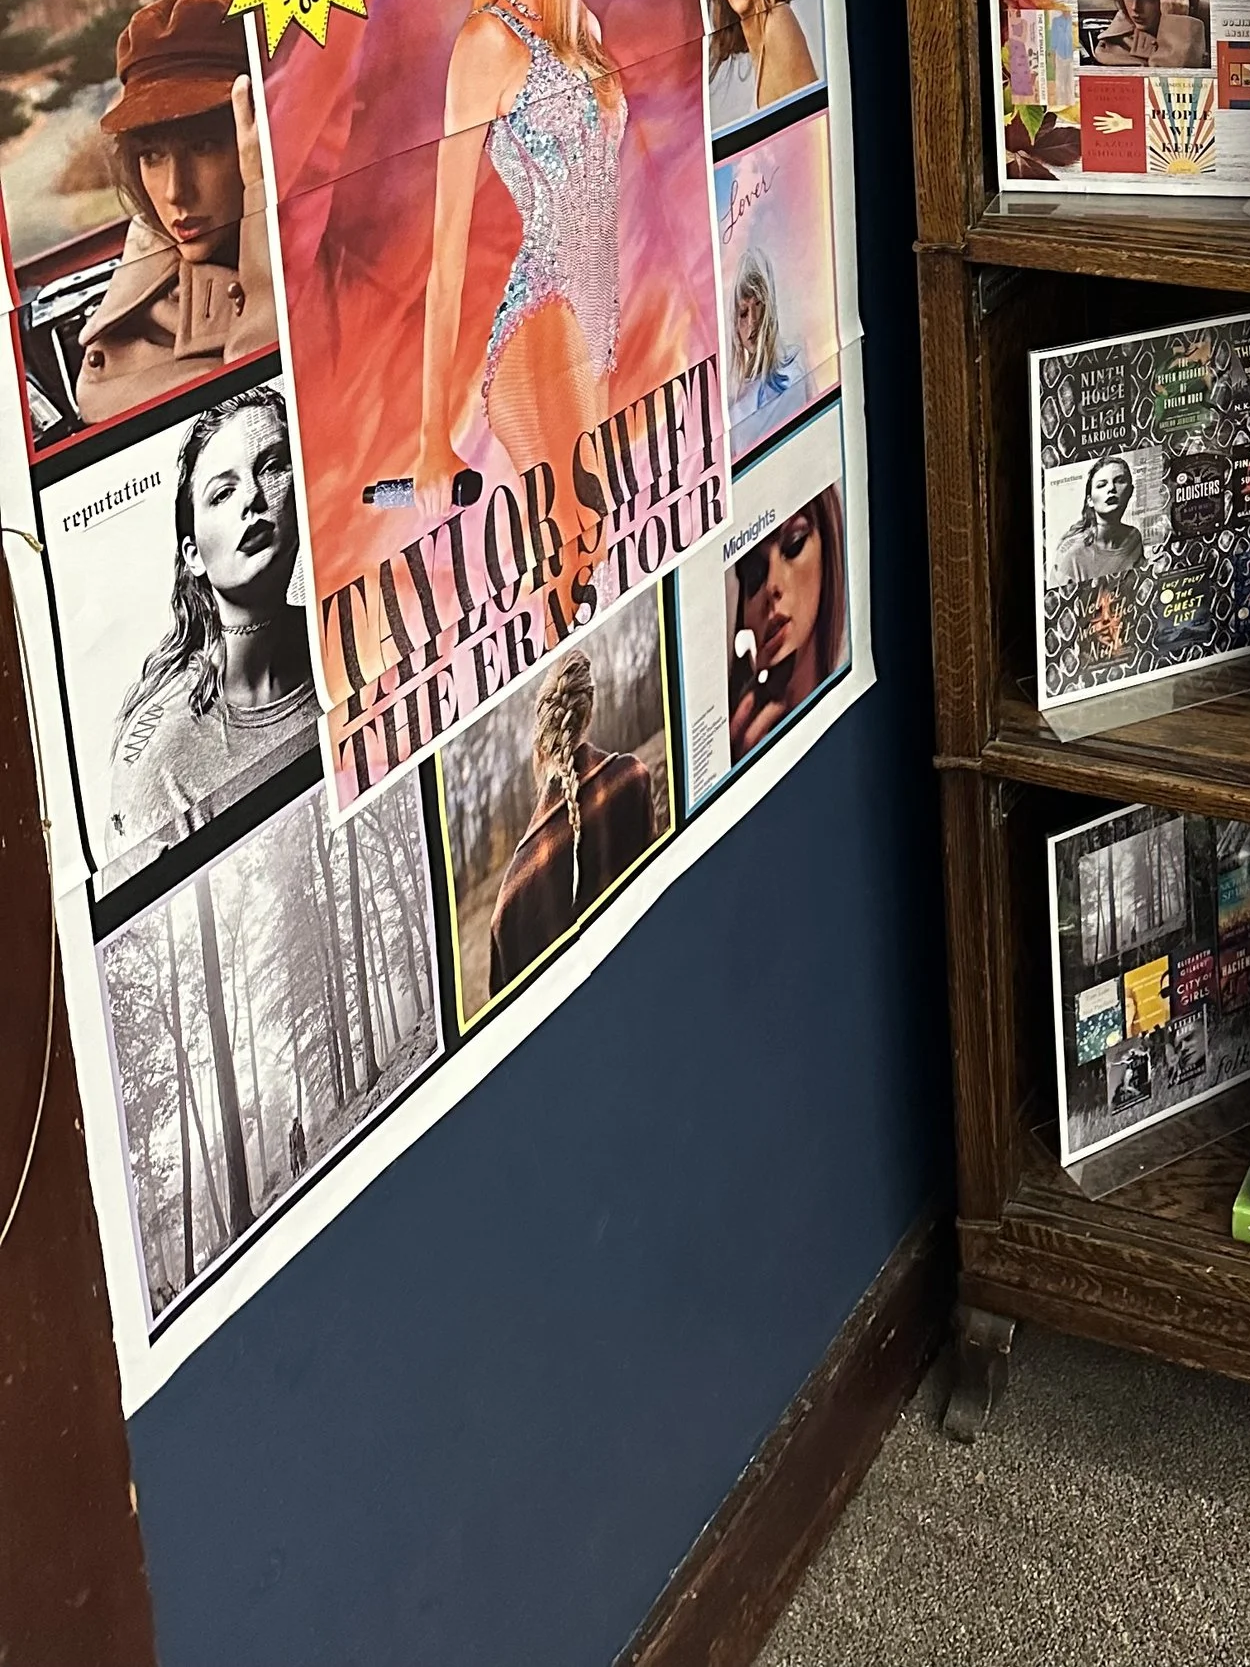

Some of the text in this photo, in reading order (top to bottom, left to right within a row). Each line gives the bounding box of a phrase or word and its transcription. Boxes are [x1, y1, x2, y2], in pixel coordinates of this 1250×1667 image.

[1151, 110, 1212, 120] PEOPLE
[718, 168, 779, 241] Lover
[1081, 365, 1125, 388] NINTH
[1081, 428, 1126, 445] BARDUGO
[62, 466, 163, 533] reputation
[1176, 481, 1219, 501] CLOISTERS
[322, 354, 718, 727] TAYLOR SWIFT
[723, 508, 775, 562] Midnights
[1164, 597, 1205, 617] GUEST
[339, 475, 724, 794] THE ERAS TOUR
[1177, 978, 1200, 995] CITY
[1181, 987, 1209, 1006] GIRLS
